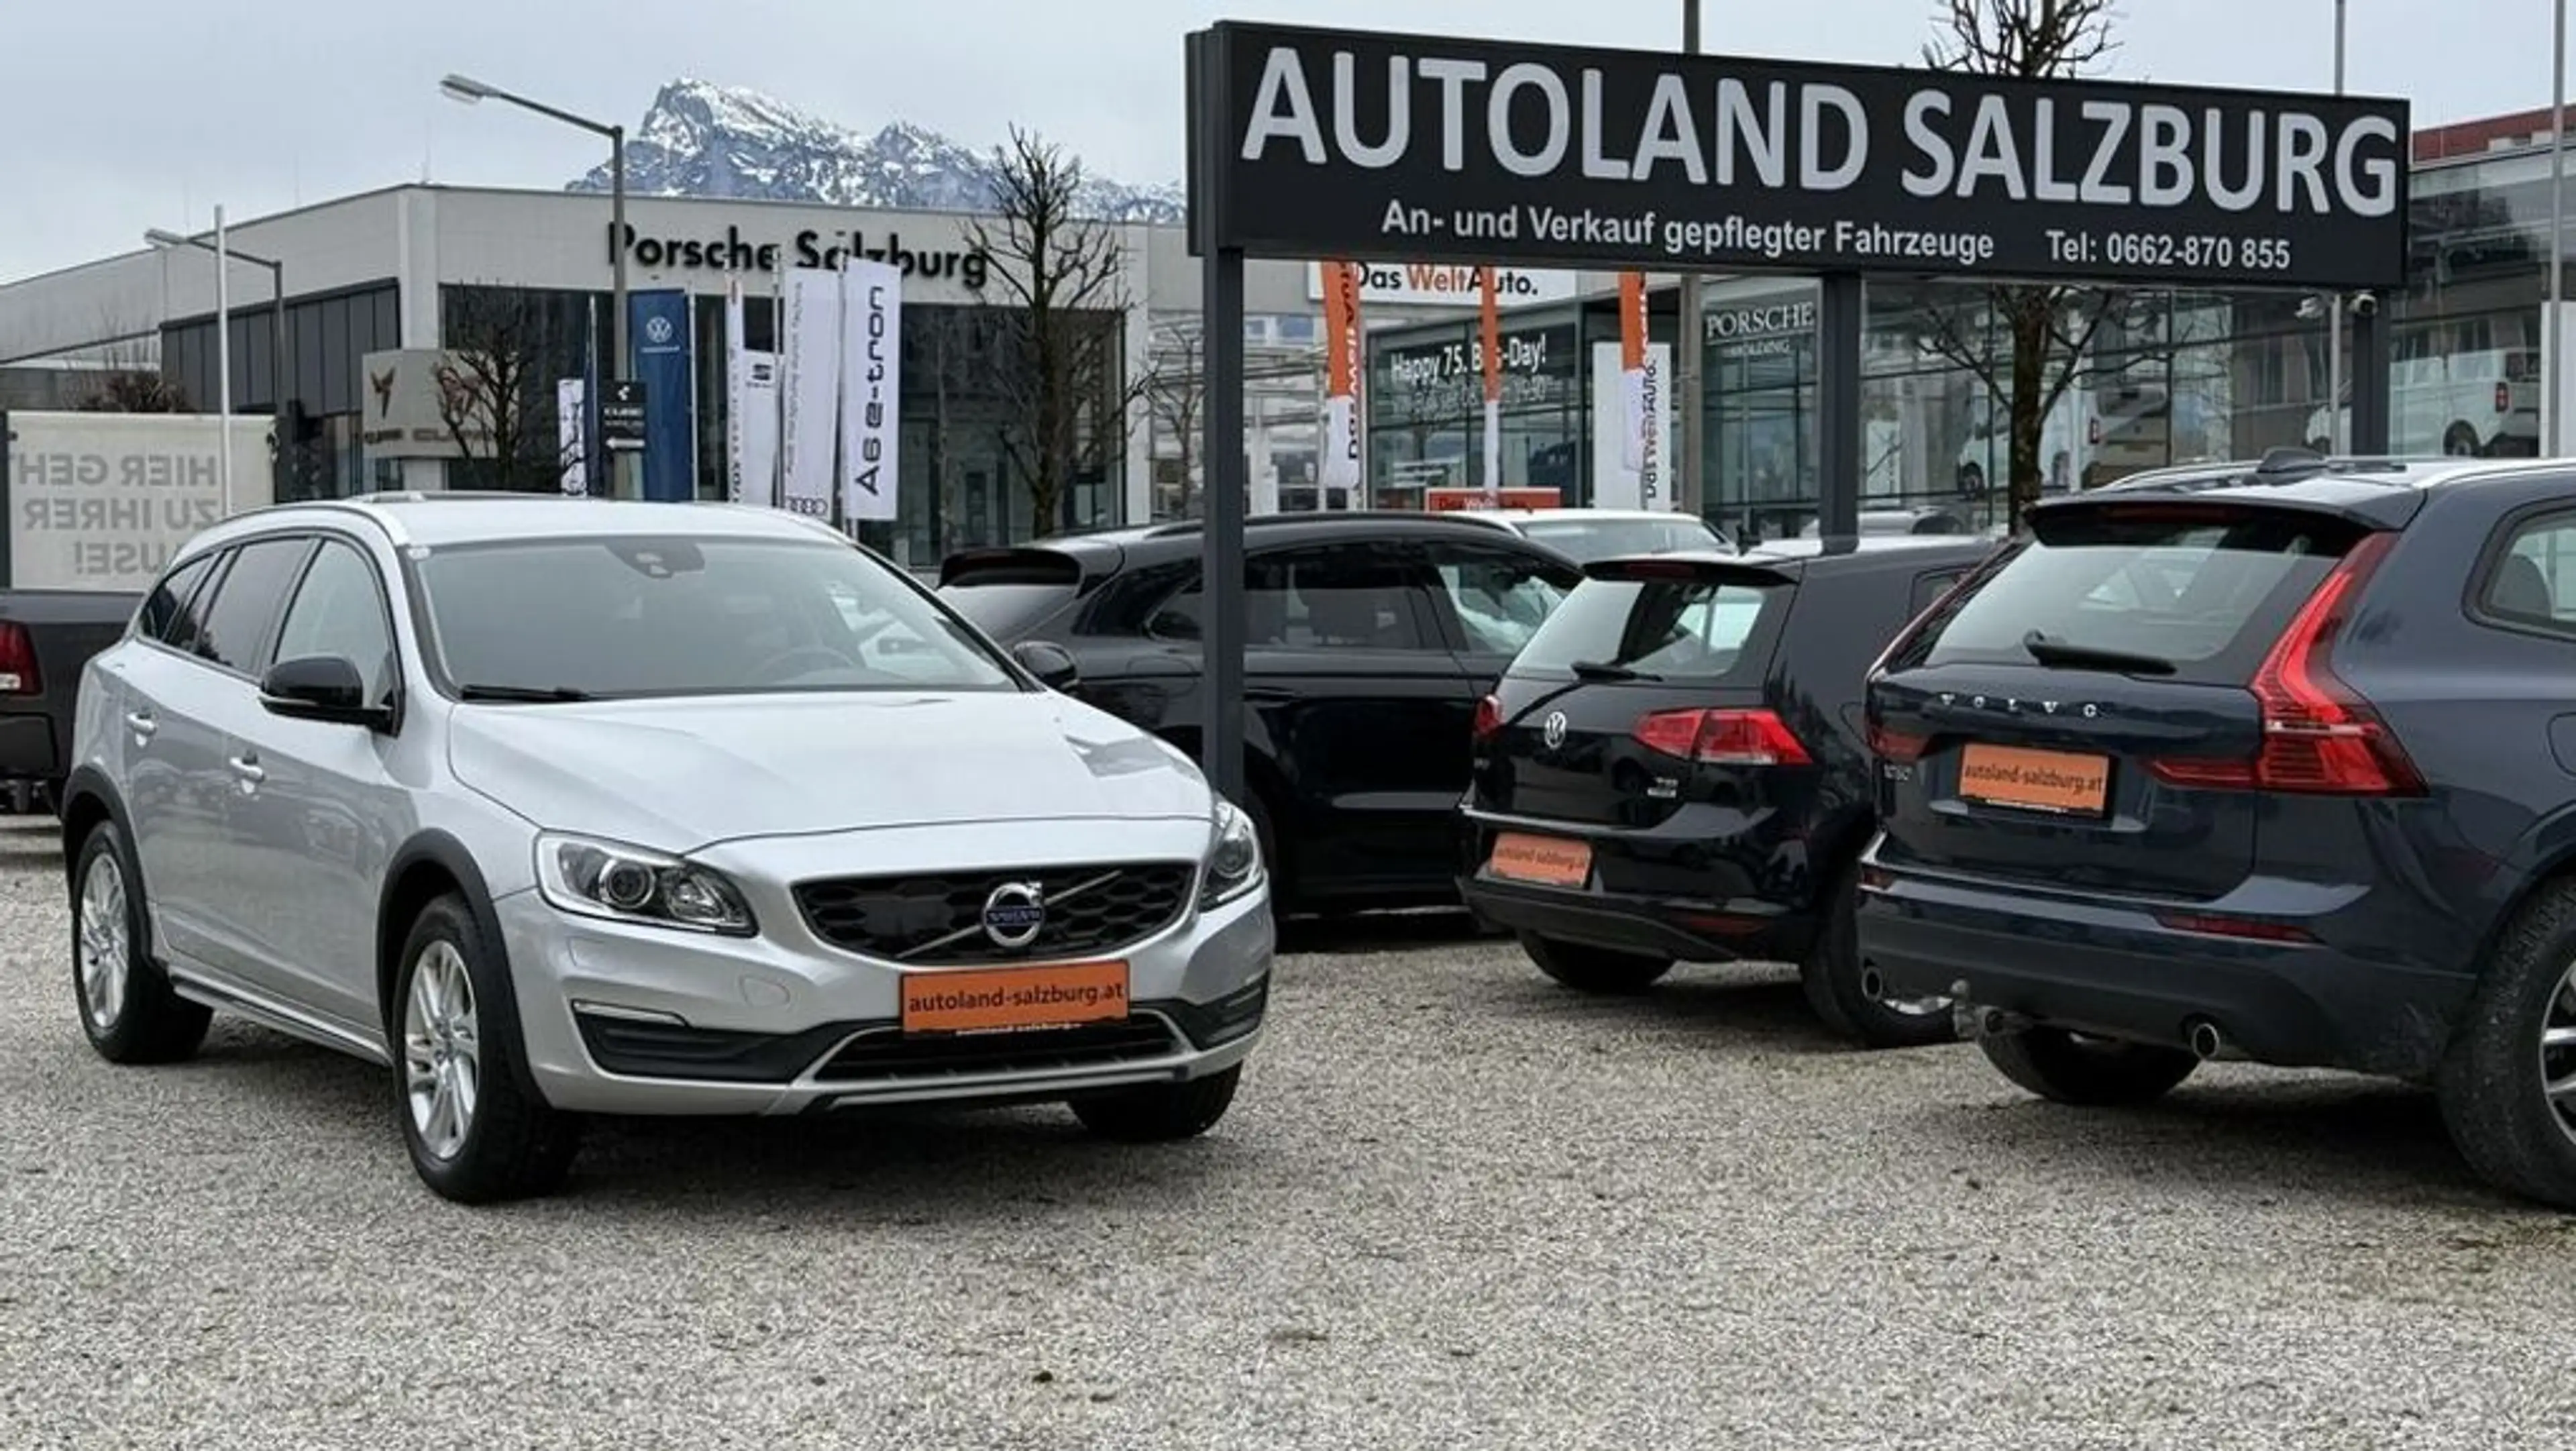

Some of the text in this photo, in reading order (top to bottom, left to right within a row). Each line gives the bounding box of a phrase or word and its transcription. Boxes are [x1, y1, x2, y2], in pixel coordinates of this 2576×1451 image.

[1242, 46, 2397, 216] AUTOLAND SALZBURG
[608, 221, 780, 270] Porsche
[1383, 199, 1994, 264] An- und Verkauf gepflegter Fahrzeuge
[2046, 230, 2290, 269] Tel: 0662-870 855
[1706, 301, 1815, 339] PORSCHE
[865, 286, 884, 429] e-tron
[1391, 352, 1440, 384] Happy
[1444, 345, 1468, 374] 75.
[1941, 694, 2097, 718] VOLVO
[1966, 763, 2102, 795] autoland-salzburg.at
[908, 981, 1126, 1013] autoland-salzburg.at
